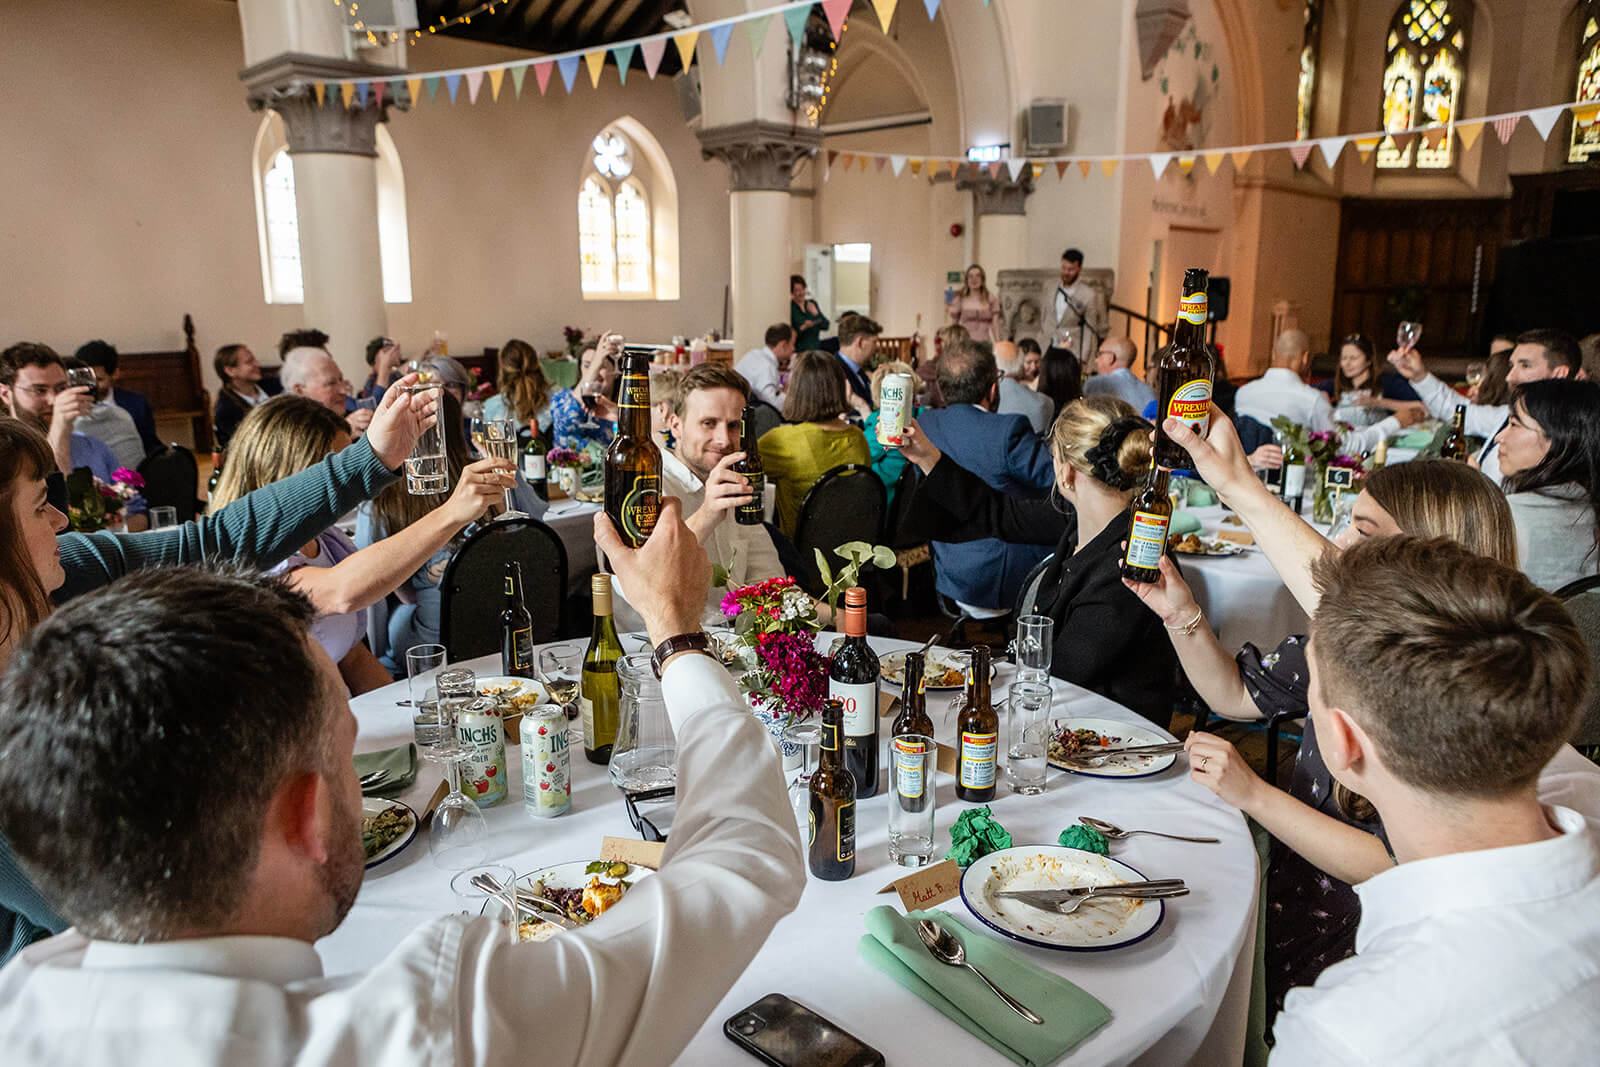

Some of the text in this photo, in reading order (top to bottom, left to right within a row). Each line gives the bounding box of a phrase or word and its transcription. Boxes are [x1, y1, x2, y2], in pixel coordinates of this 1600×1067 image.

[882, 387, 904, 401] NCH'S
[1334, 471, 1343, 483] 6
[550, 728, 568, 753] INC
